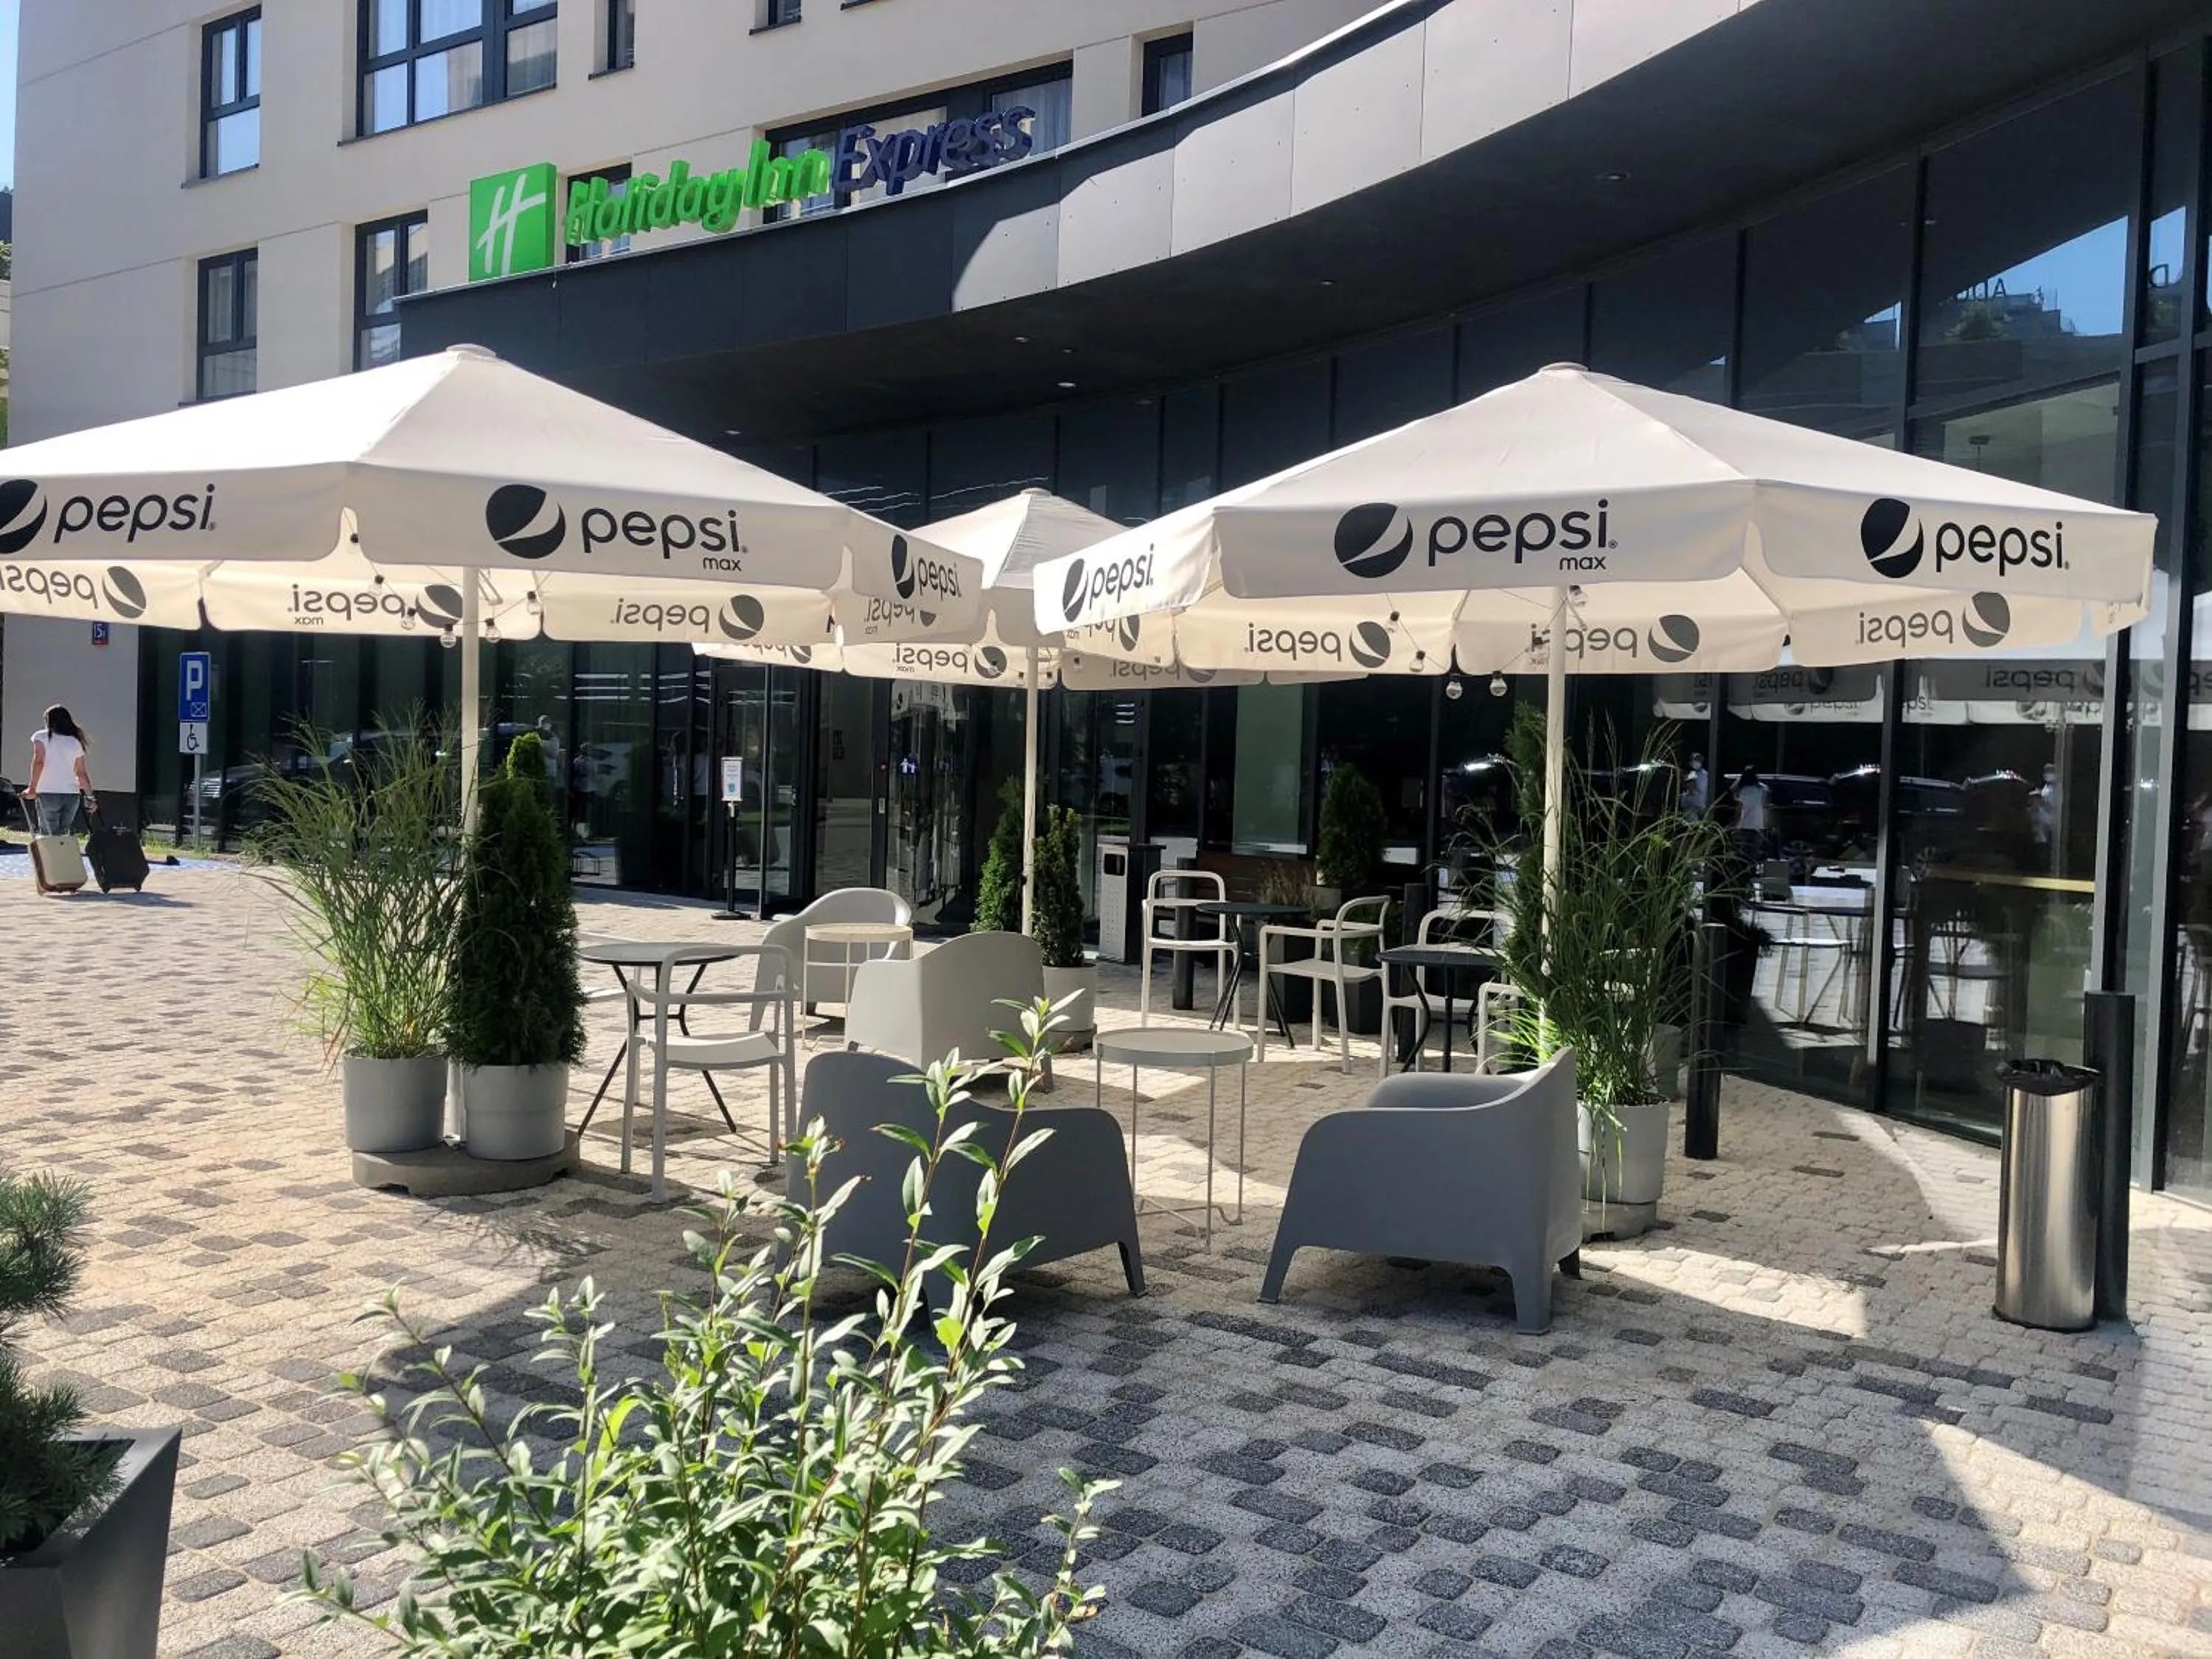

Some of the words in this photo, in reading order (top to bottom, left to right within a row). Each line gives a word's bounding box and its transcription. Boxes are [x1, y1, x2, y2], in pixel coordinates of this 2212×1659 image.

[564, 159, 746, 246] Holiday
[744, 138, 831, 209] Inn
[832, 105, 1035, 196] Express
[54, 484, 215, 543] pepsi
[581, 507, 740, 559] pepsi
[1428, 498, 1608, 566] pepsi
[703, 557, 742, 571] max
[1559, 554, 1607, 571] max
[1935, 521, 2063, 577] pepsi
[918, 557, 961, 601] pepsi
[1088, 542, 1154, 611] pepsi
[186, 660, 203, 701] P
